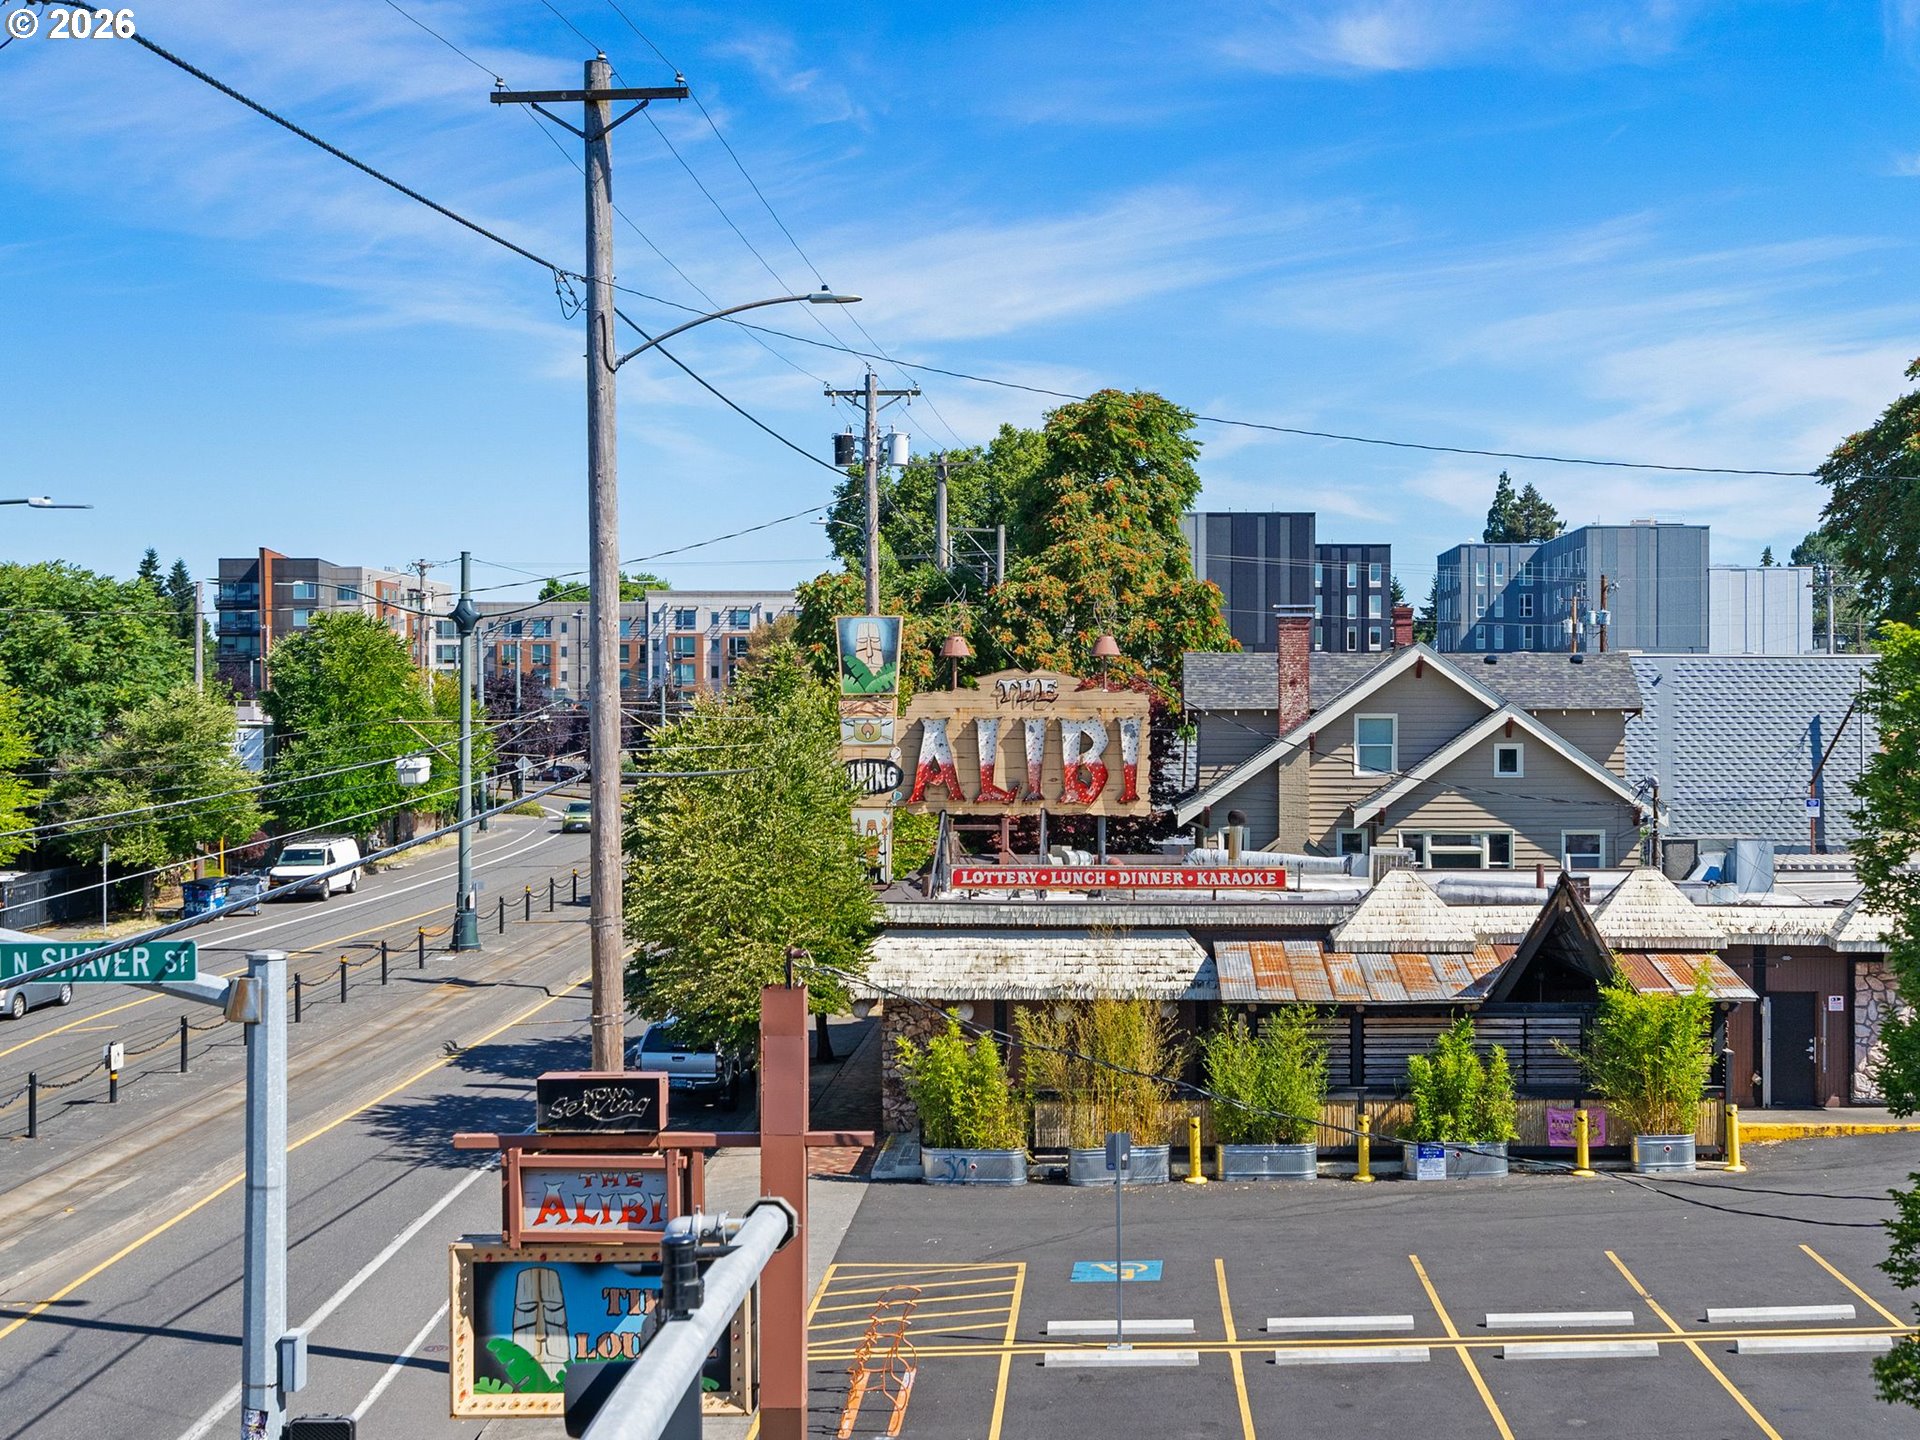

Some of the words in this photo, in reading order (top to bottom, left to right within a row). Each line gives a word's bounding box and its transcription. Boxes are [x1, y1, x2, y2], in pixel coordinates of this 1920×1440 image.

[996, 678, 1059, 704] THE
[906, 716, 1144, 805] ALIBI
[846, 762, 898, 791] INING
[961, 870, 1038, 886] LOTTERY
[1050, 870, 1107, 886] LUNCH
[1119, 870, 1184, 886] DINNER
[1196, 870, 1278, 886] KARAOKE
[14, 951, 28, 975] N
[41, 947, 150, 978] SHAVER
[164, 950, 190, 974] ST
[578, 1171, 644, 1188] THE
[532, 1181, 666, 1226] ALIBI
[602, 1287, 654, 1316] TI
